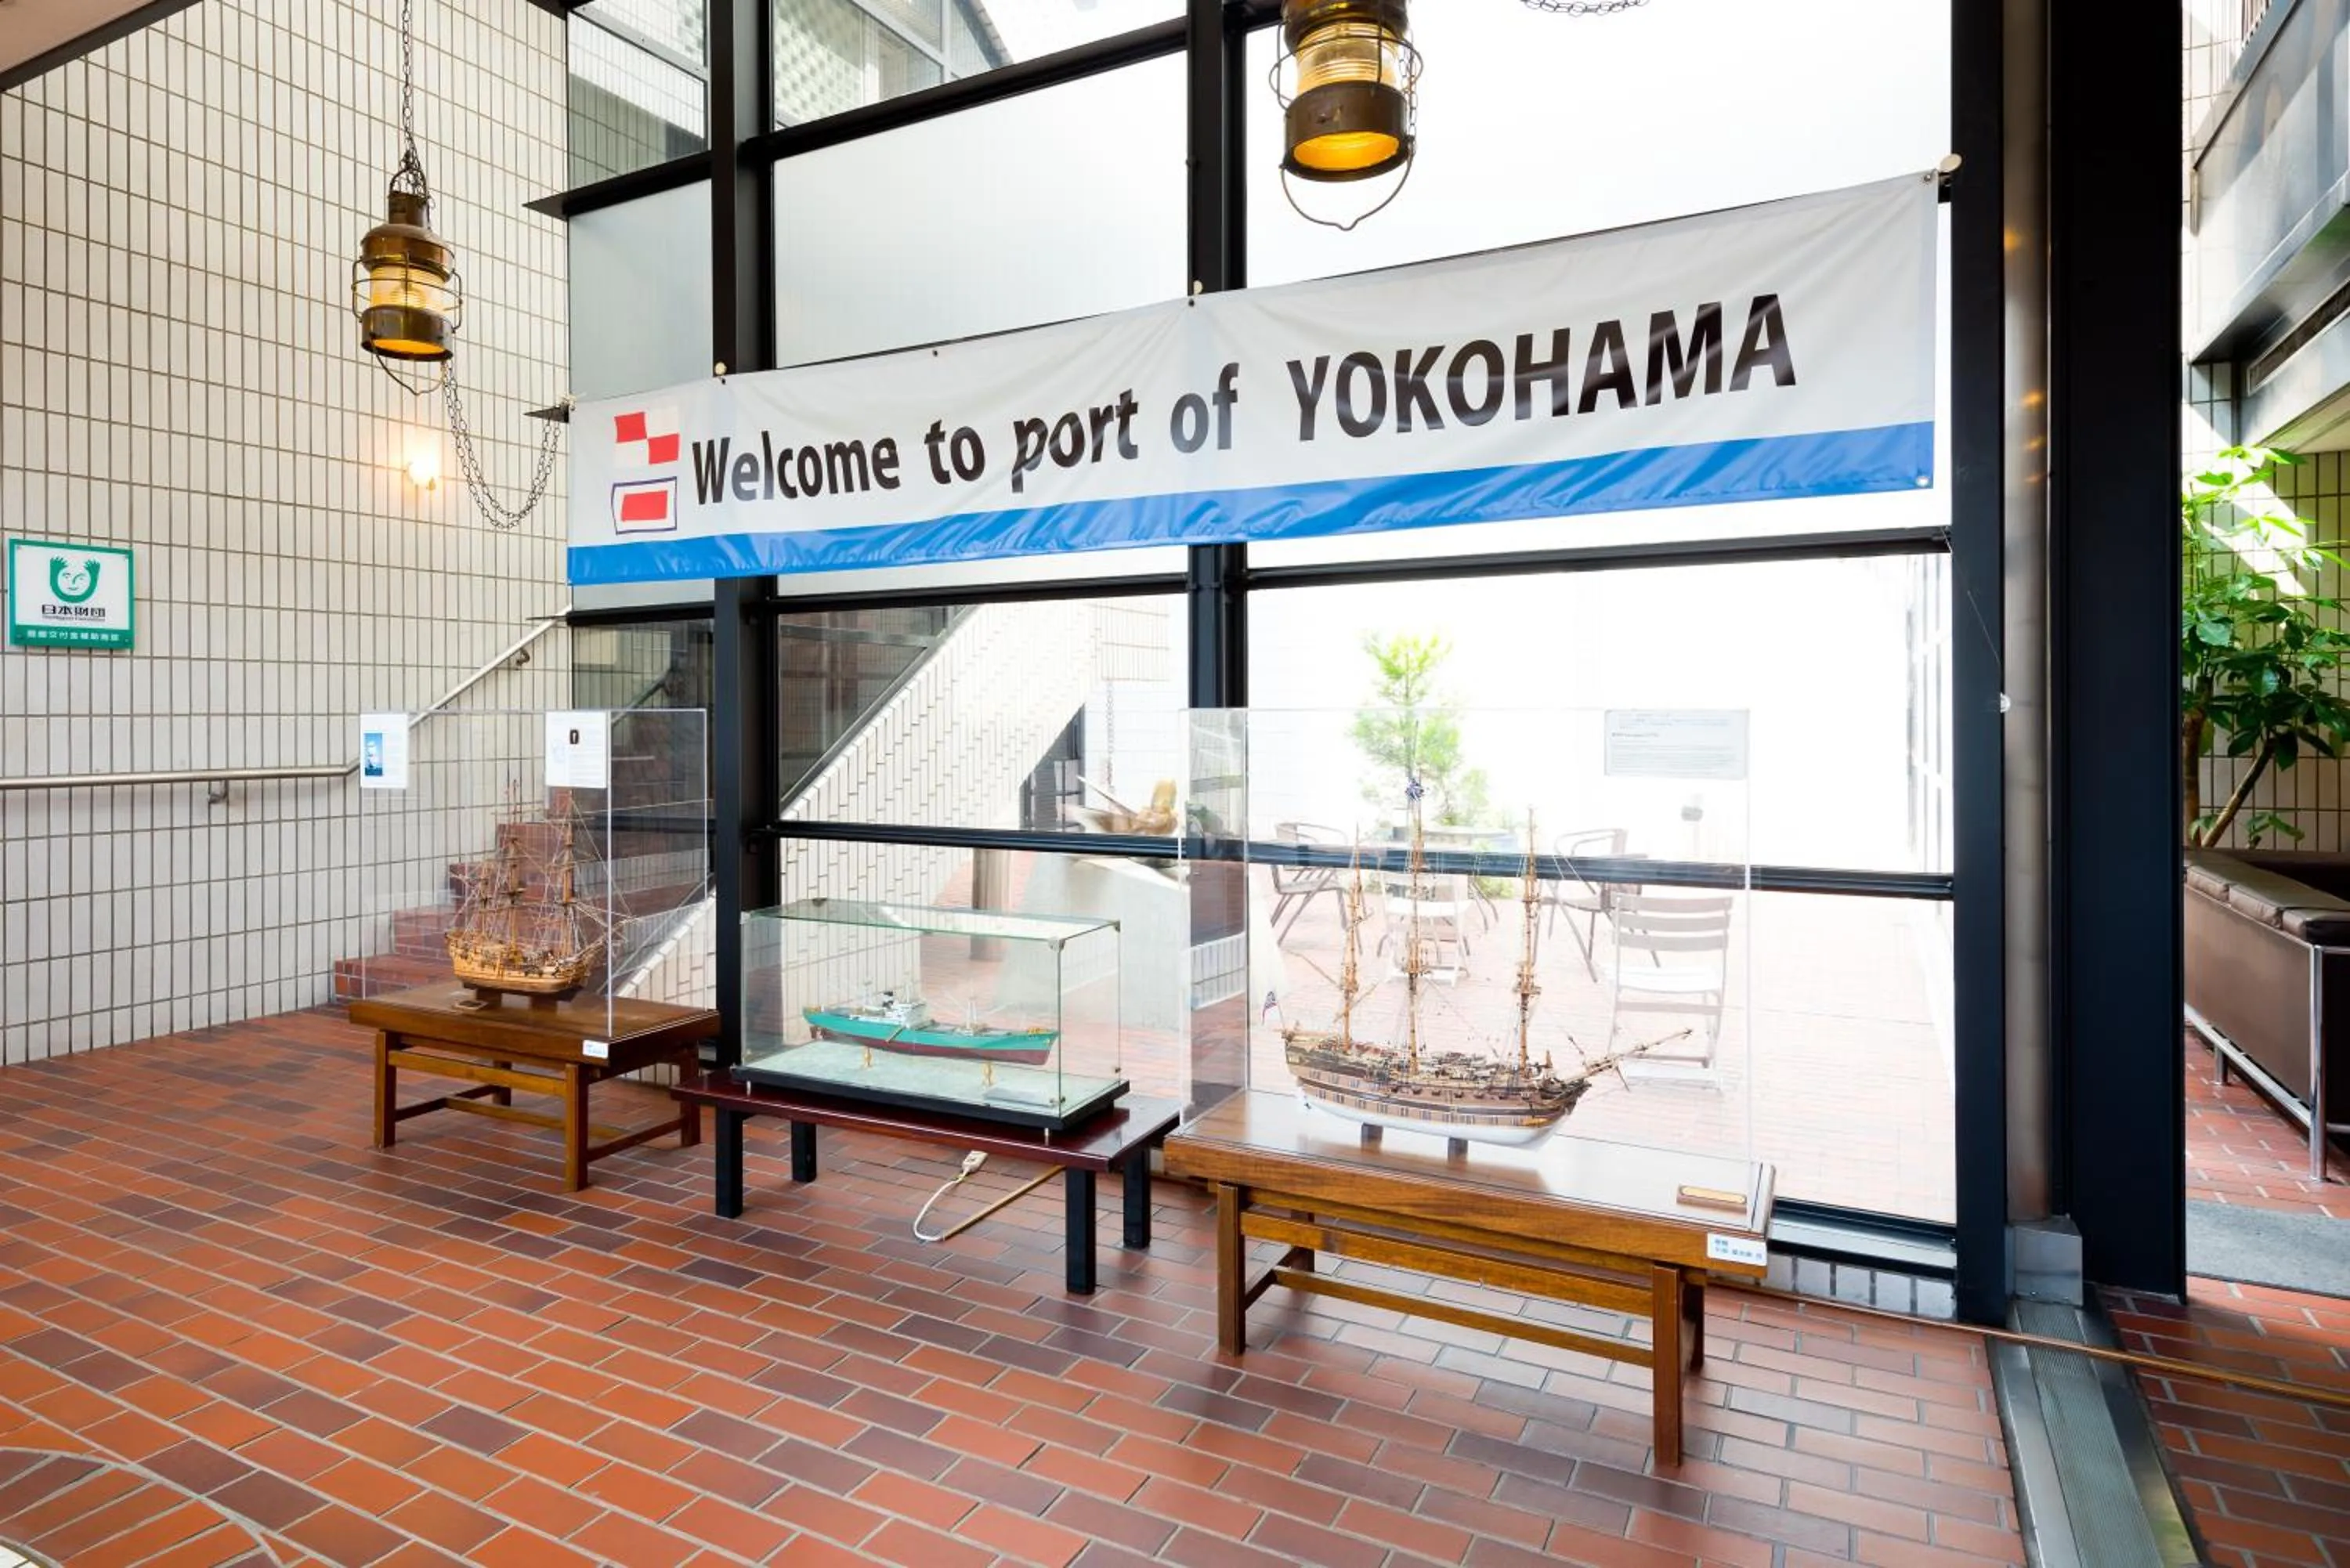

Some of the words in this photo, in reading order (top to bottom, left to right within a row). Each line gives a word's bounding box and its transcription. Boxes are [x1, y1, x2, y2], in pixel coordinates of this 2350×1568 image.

[692, 430, 900, 505] Welcome
[924, 419, 985, 484] to
[1011, 388, 1138, 493] port
[1170, 362, 1239, 453] of
[1286, 293, 1797, 442] YOKOHAMA
[42, 604, 106, 617] 日本財団
